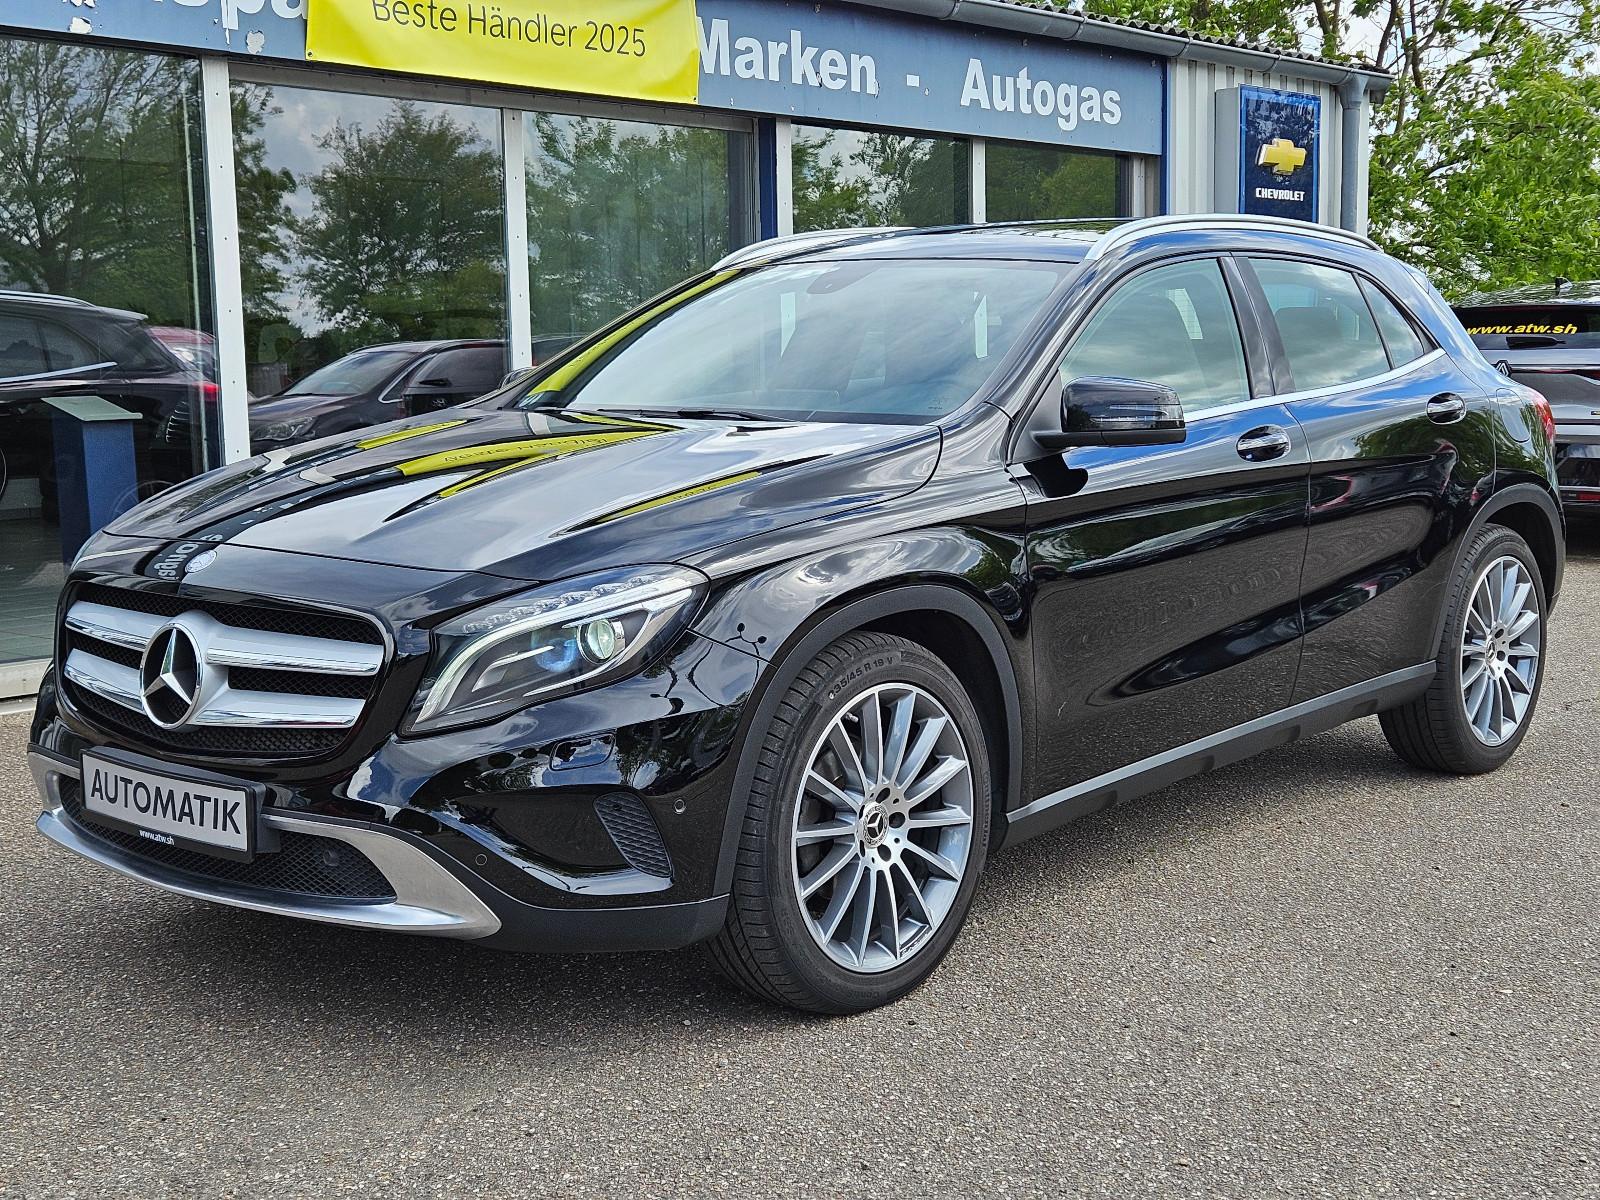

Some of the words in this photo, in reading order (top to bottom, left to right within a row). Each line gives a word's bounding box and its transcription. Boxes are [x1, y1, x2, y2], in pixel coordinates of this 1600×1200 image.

[372, 0, 458, 32] Beste
[467, 3, 578, 48] Händler
[584, 20, 647, 57] 2025
[695, 16, 878, 96] Marken
[960, 58, 1122, 131] Autogas
[1255, 187, 1306, 202] CHEVROLET
[1466, 323, 1578, 335] www.atw.sh
[90, 768, 241, 835] AUTOMATIK
[139, 829, 175, 846] www.atw.sh
